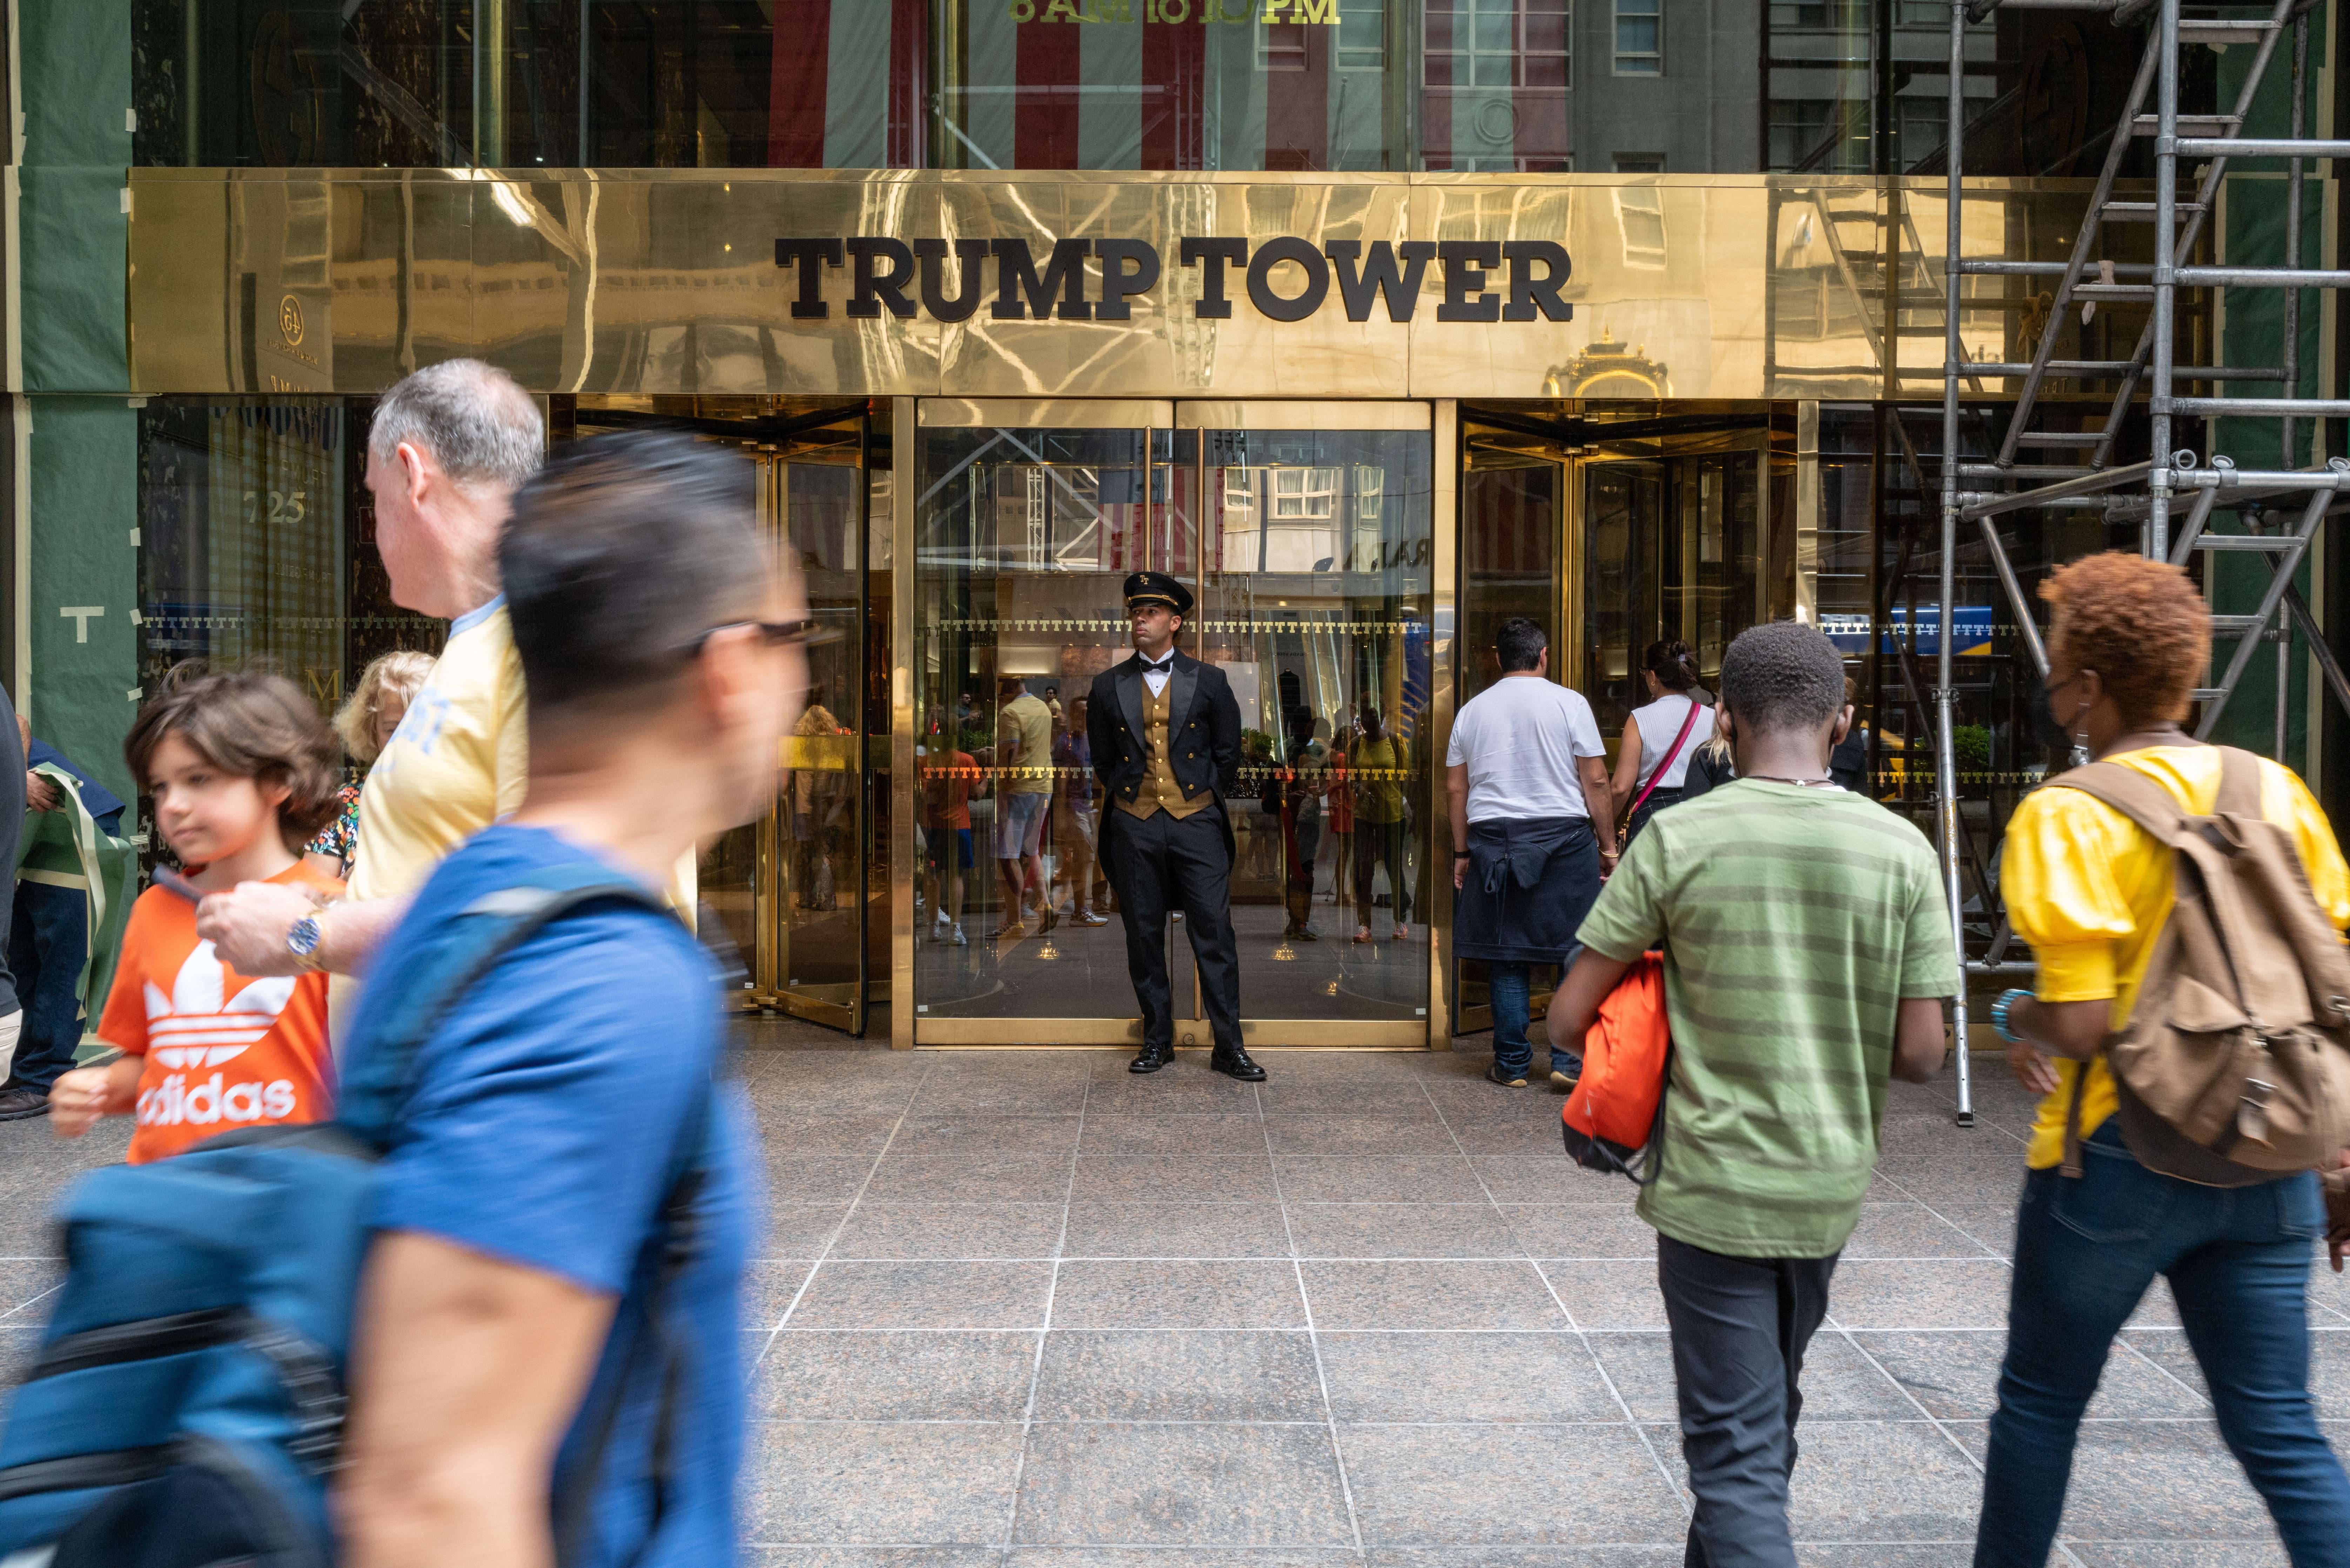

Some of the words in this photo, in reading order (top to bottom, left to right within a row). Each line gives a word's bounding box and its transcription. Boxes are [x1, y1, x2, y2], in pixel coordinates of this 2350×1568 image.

[775, 237, 1161, 323] TRUMP
[1181, 237, 1574, 323] TOWER
[243, 491, 306, 524] 725
[1139, 575, 1149, 585] TT
[60, 606, 105, 643] T
